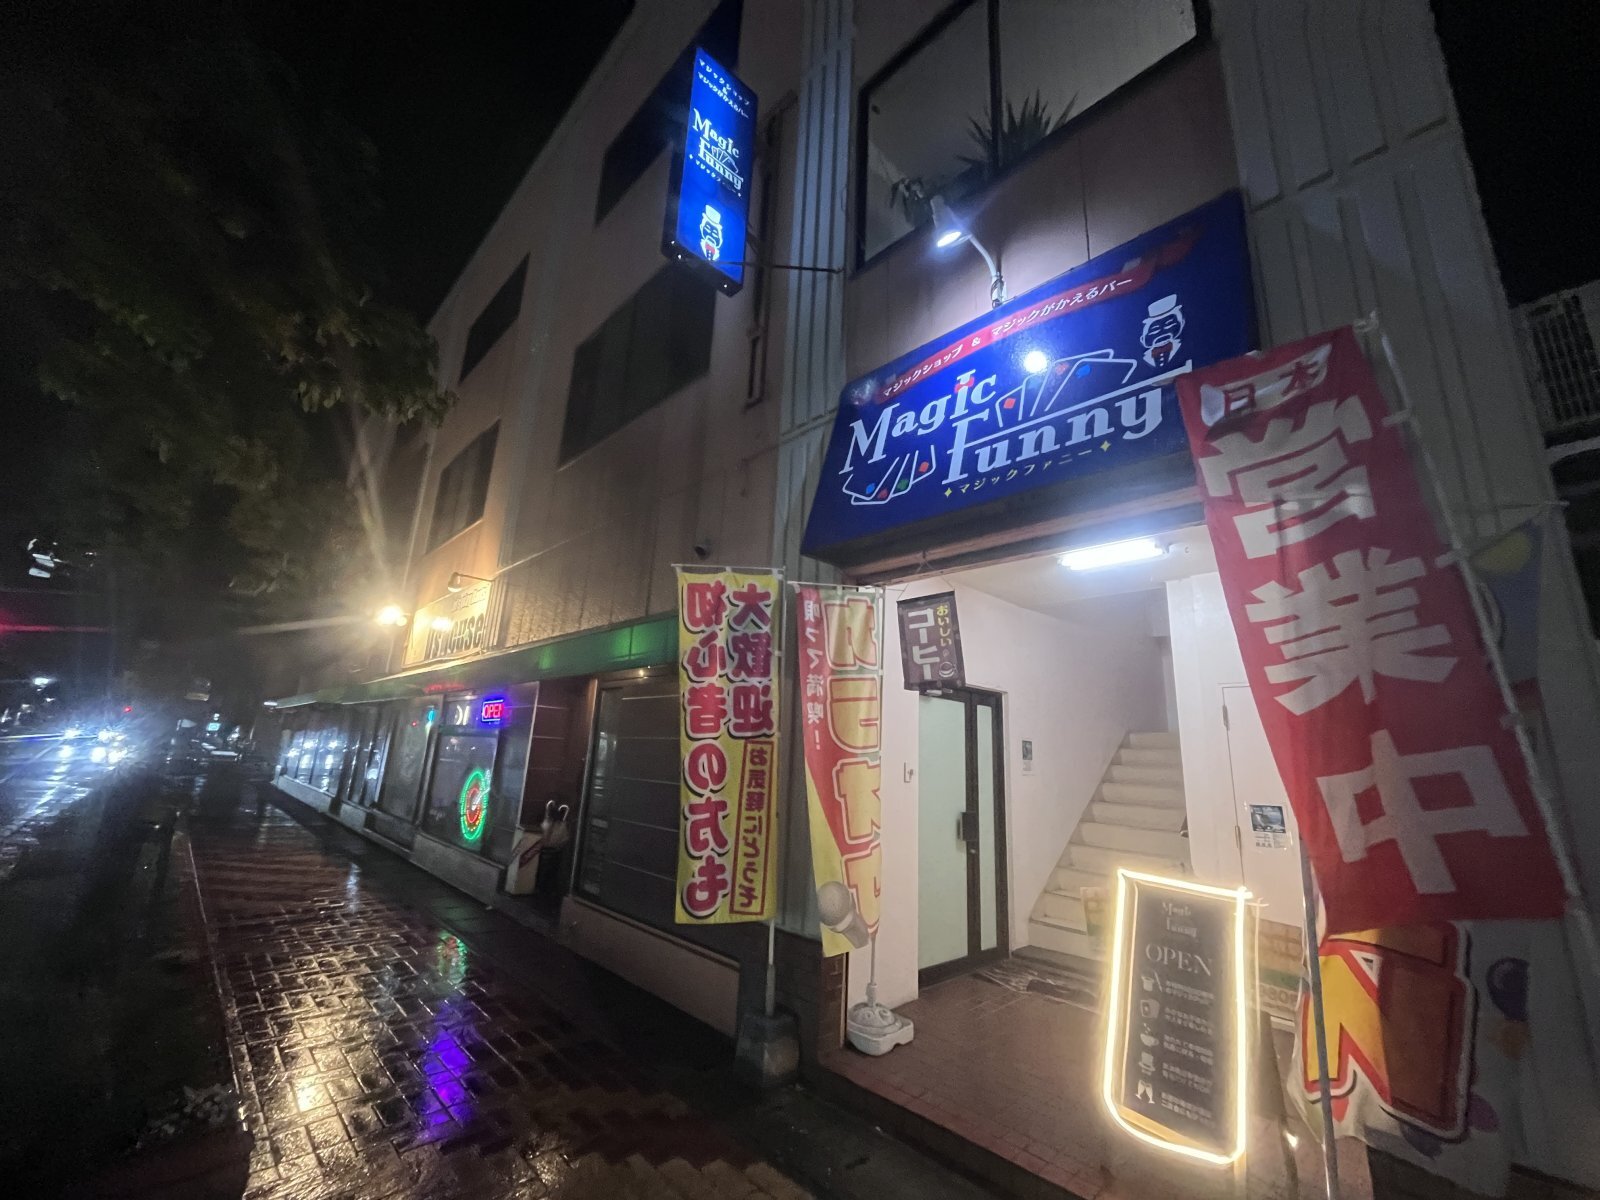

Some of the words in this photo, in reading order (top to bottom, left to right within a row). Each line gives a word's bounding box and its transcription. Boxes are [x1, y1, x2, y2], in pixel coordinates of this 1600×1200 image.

[692, 107, 739, 159] Magic
[698, 136, 744, 190] Funny
[883, 343, 964, 396] マジックショップ
[970, 336, 981, 348] &
[991, 278, 1133, 337] マジックがかえるバー
[839, 368, 998, 475] Magic
[941, 378, 1175, 485] Funny
[959, 448, 1093, 494] マジックファニー
[907, 607, 941, 681] コーヒー
[936, 604, 953, 648] おいしい
[1144, 943, 1212, 977] OPEN
